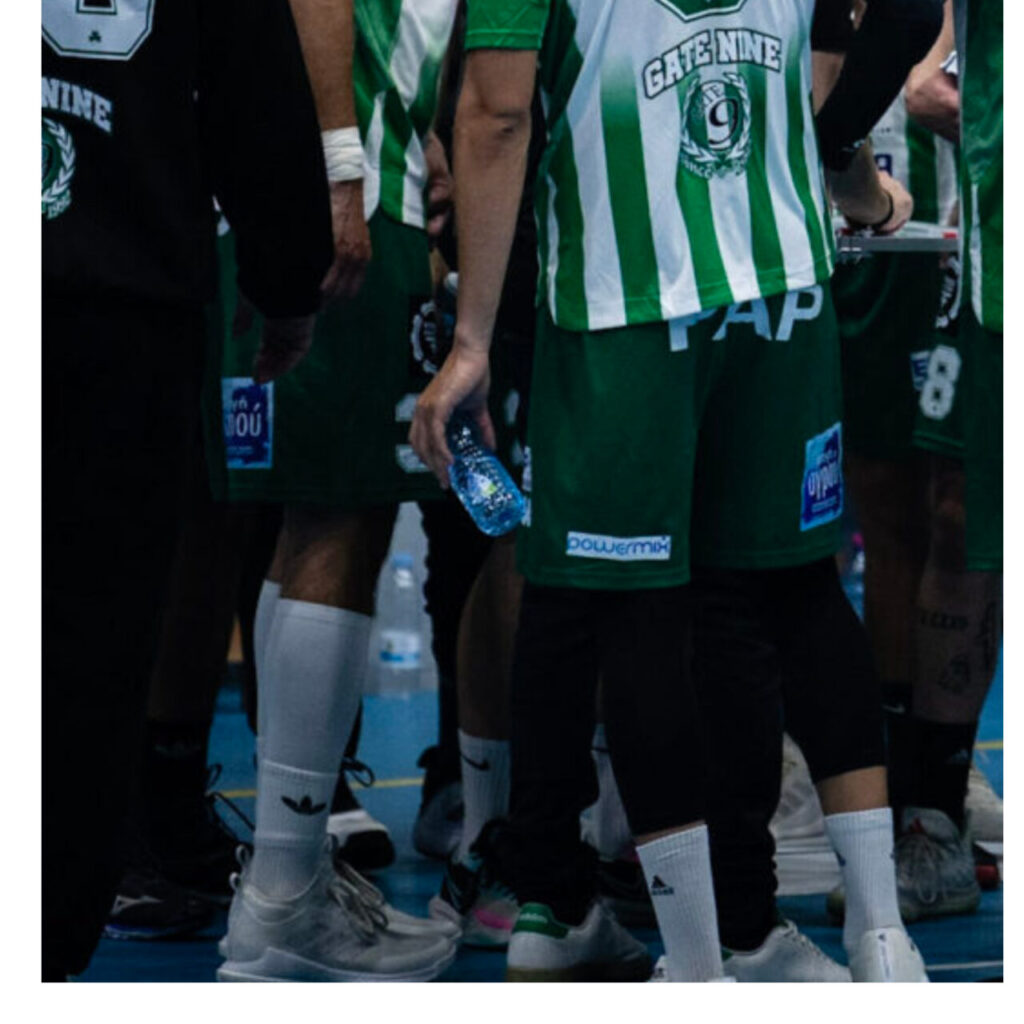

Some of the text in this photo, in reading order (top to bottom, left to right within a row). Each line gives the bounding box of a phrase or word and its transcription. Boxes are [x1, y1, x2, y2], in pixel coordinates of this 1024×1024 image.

[642, 28, 783, 100] GATE NINE
[41, 77, 113, 133] NINE
[919, 344, 962, 421] 8
[567, 535, 669, 556] powermix
